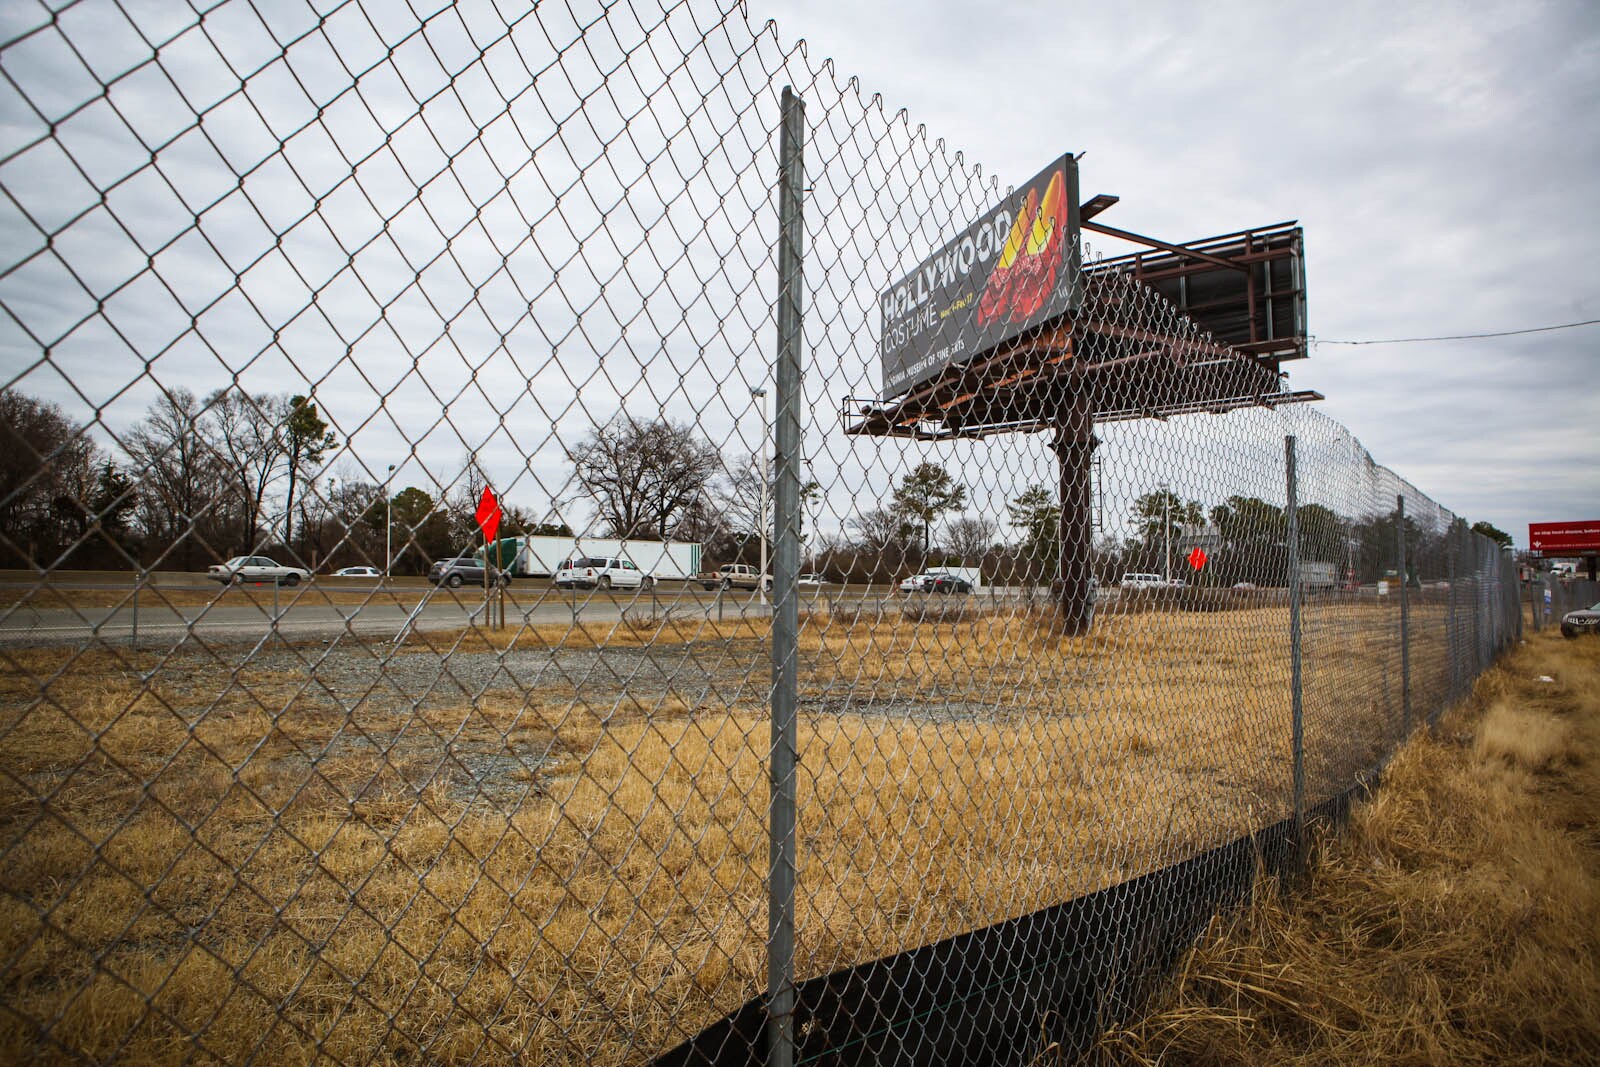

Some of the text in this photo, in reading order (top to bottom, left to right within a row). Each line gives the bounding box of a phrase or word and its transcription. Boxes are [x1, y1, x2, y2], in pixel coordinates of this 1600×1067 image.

[884, 210, 1012, 328] HOLLYWOOD
[885, 303, 938, 353] COSTUME
[928, 355, 936, 366] OF
